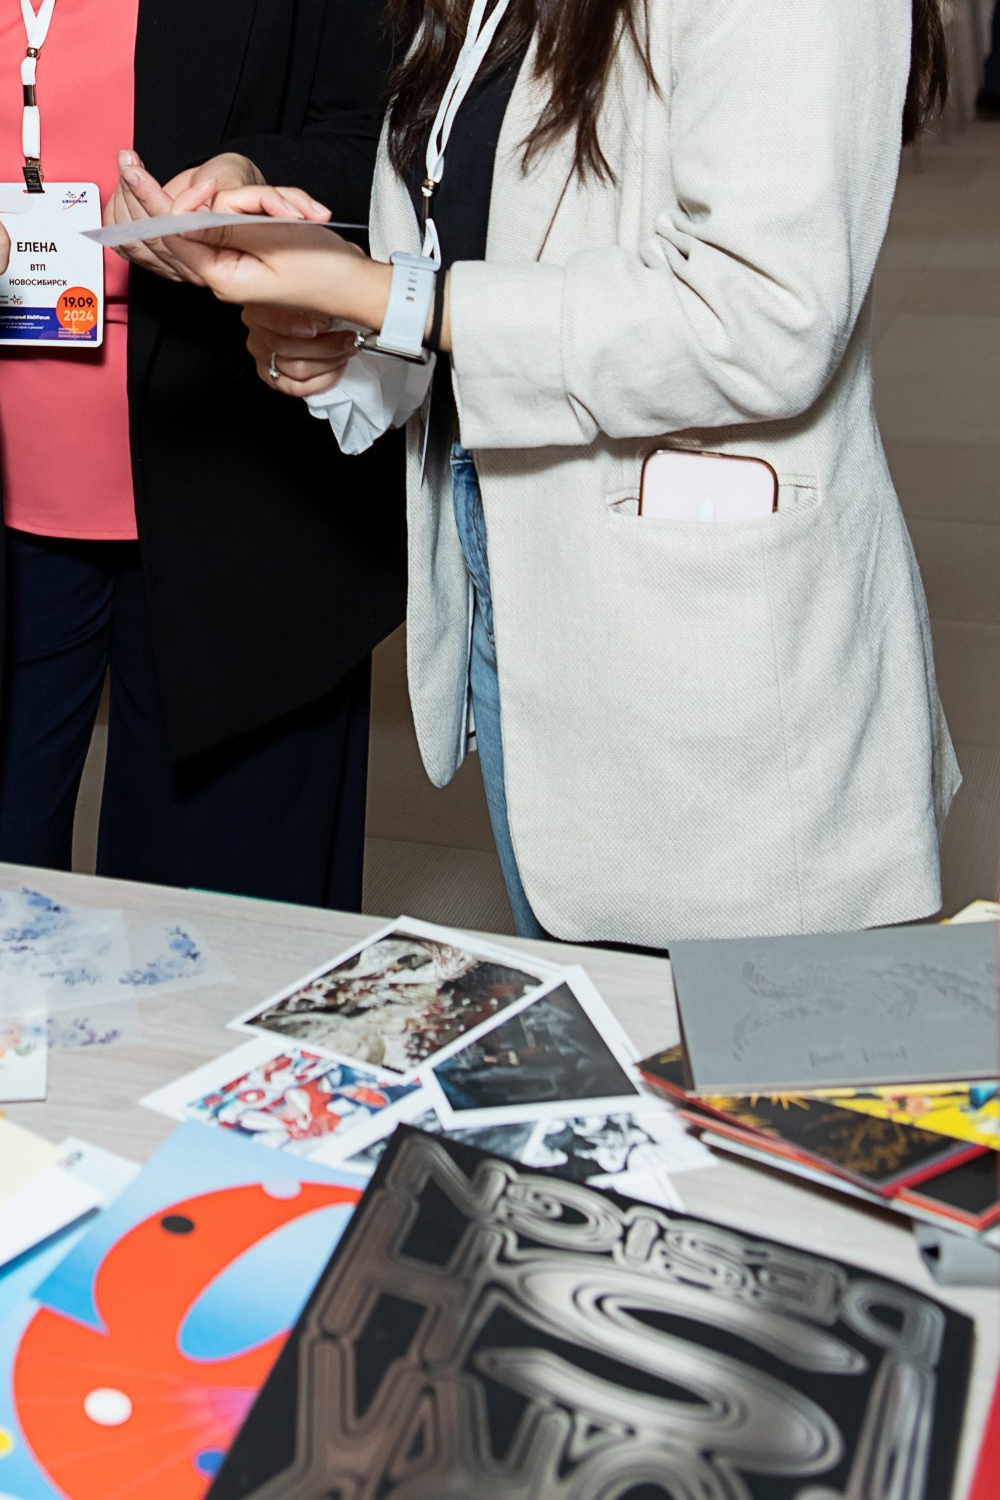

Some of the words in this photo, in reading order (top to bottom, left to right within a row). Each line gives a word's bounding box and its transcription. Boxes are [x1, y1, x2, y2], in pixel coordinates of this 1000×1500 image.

[16, 241, 58, 253] ЕЛЕНА
[30, 263, 46, 271] ВТП
[9, 278, 68, 287] НОВОСИБИРСК
[63, 296, 95, 308] 19.09.
[63, 310, 95, 322] 2024
